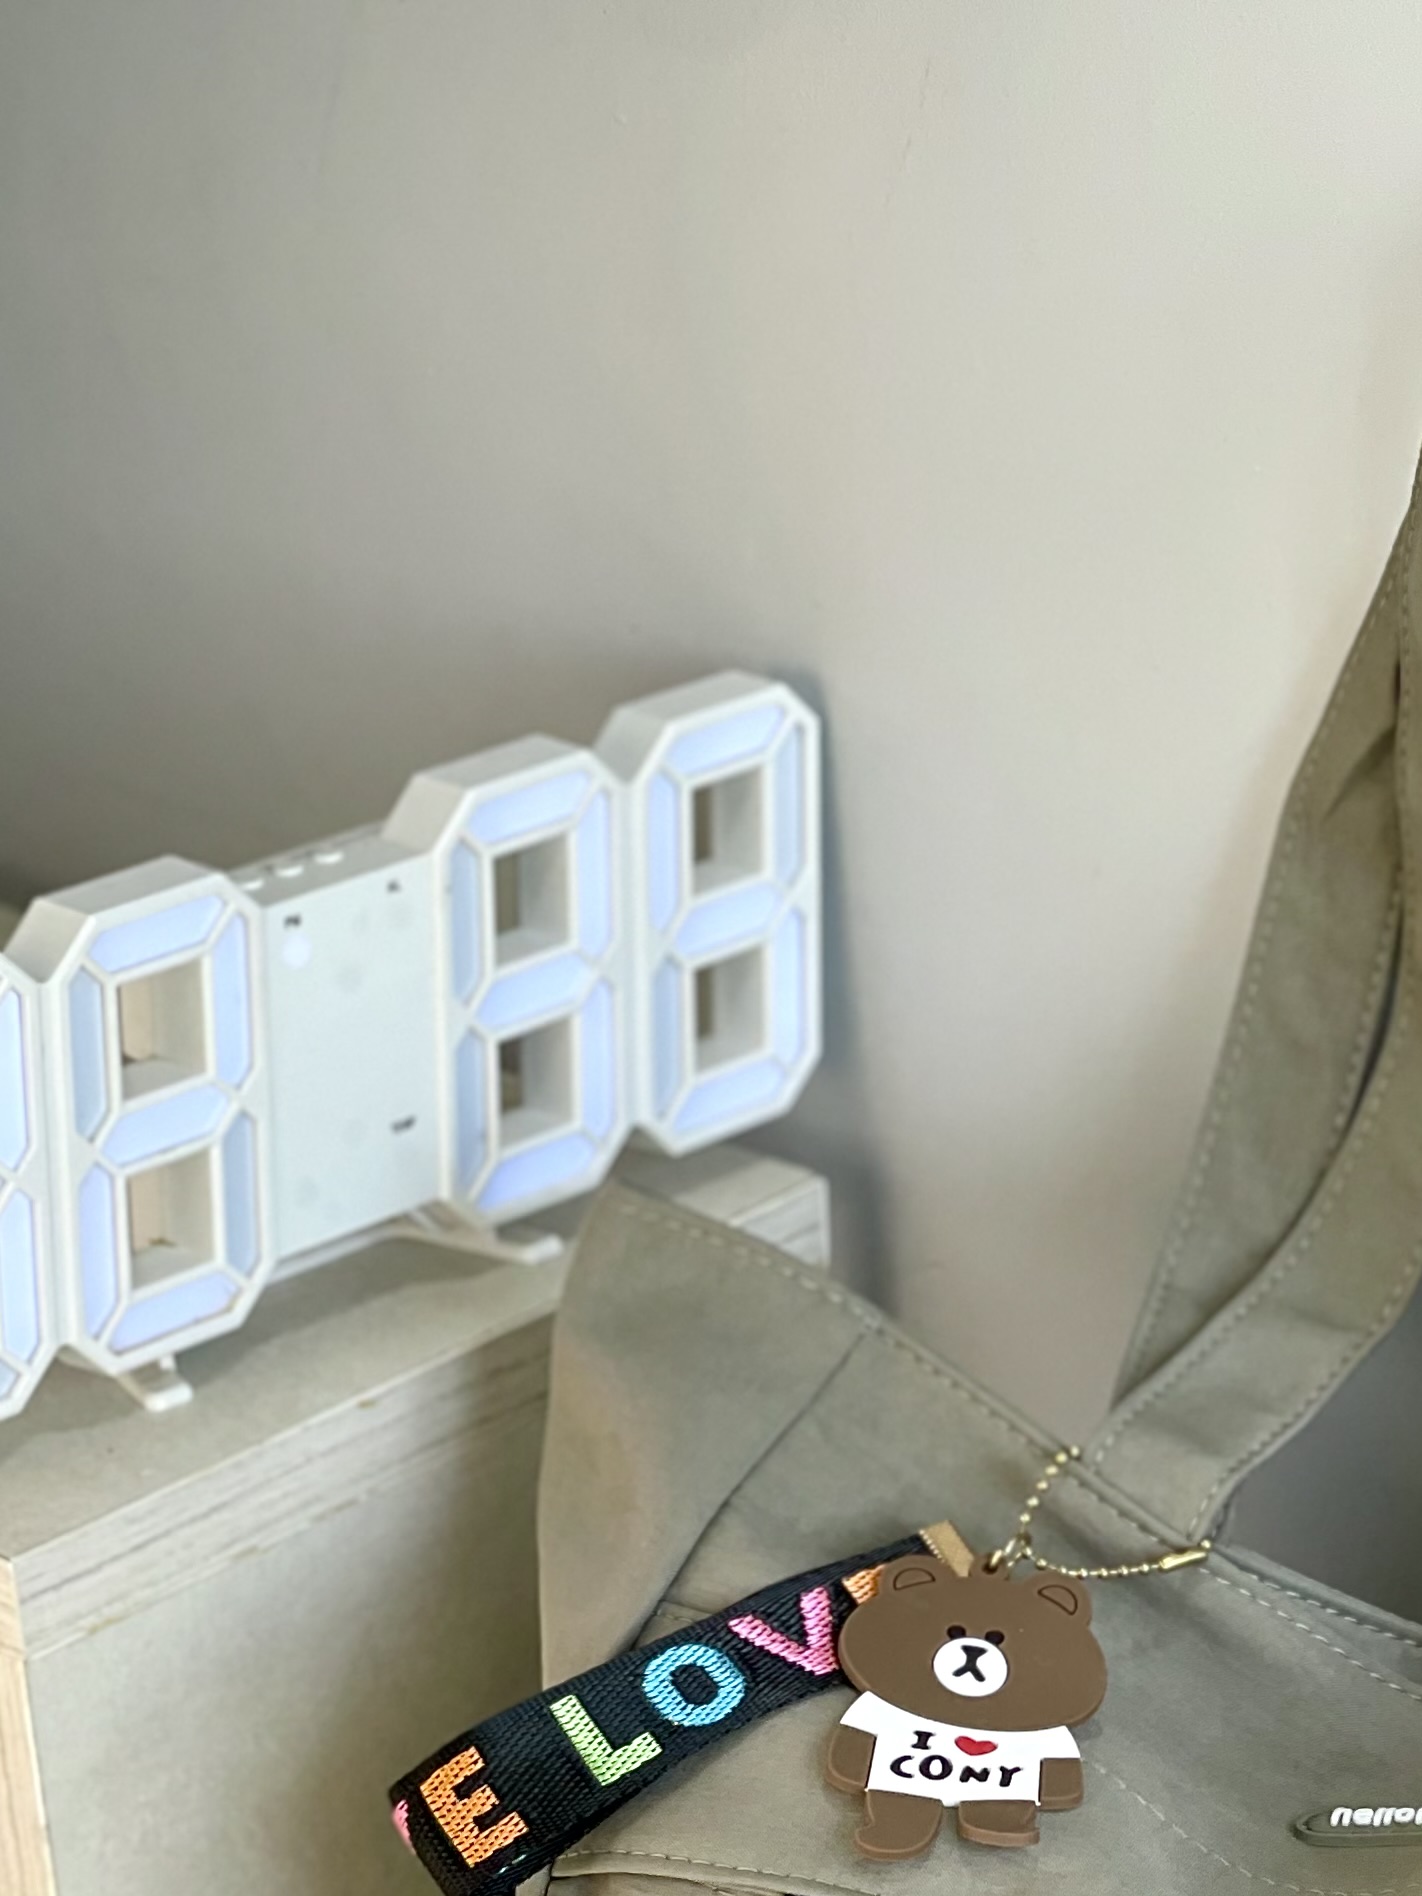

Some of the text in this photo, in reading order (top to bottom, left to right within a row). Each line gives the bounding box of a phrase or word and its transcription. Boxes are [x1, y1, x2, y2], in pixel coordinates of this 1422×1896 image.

[549, 1565, 885, 1788] LOV
[911, 1730, 936, 1750] I
[890, 1754, 1023, 1787] CONY
